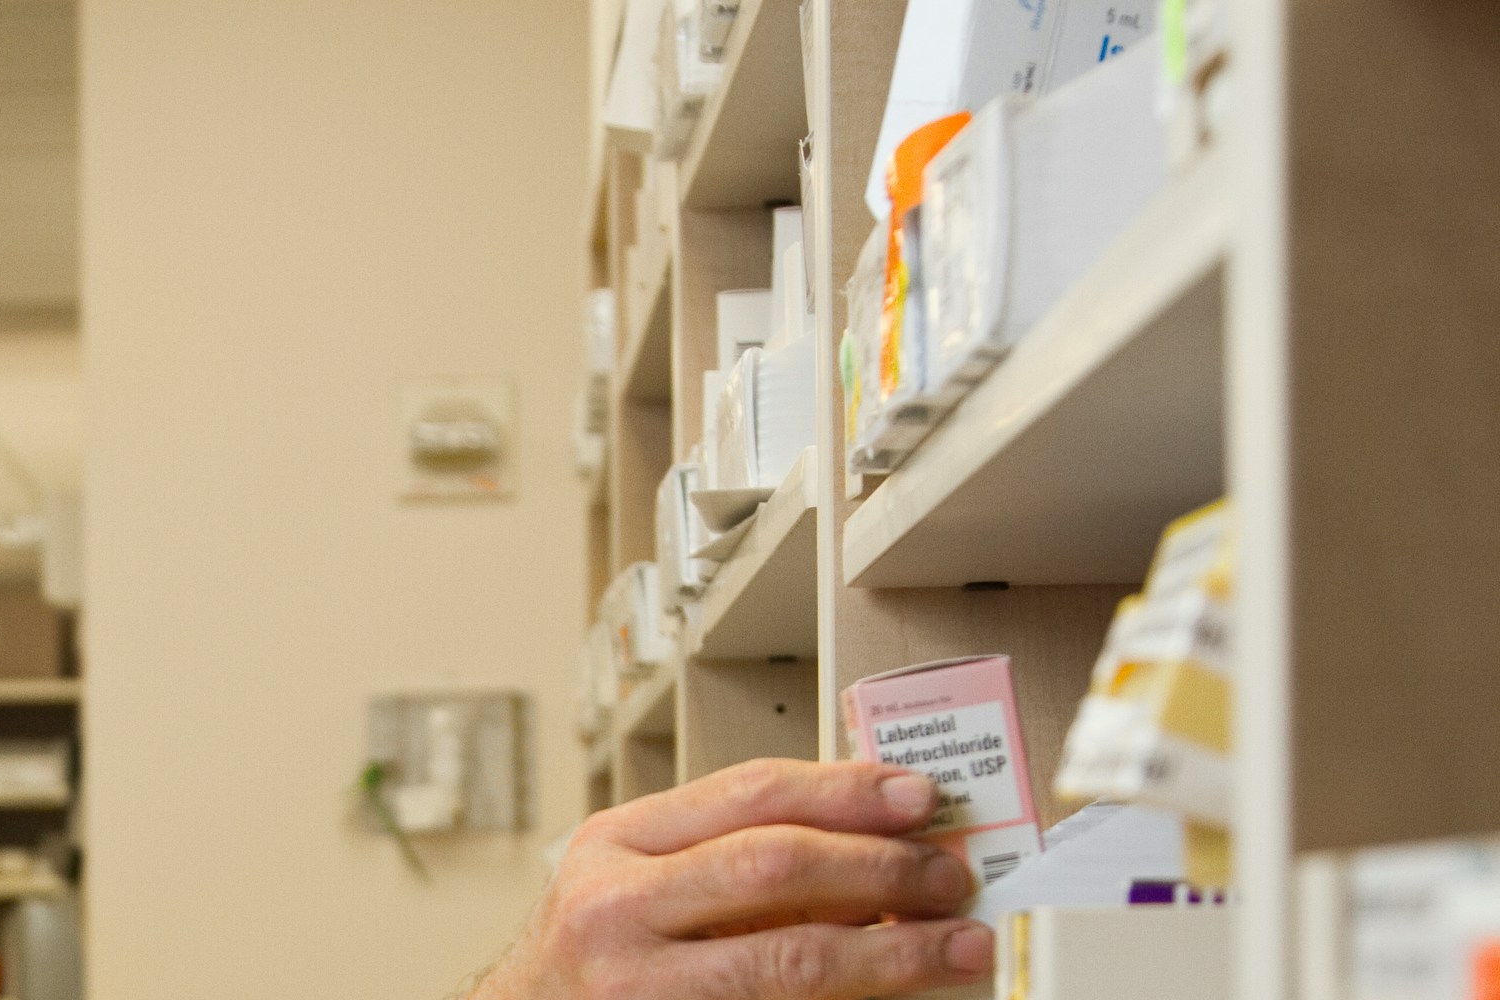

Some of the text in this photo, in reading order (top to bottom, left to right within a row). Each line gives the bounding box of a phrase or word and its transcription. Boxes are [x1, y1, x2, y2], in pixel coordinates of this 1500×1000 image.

[876, 713, 957, 745] Labetalol
[881, 732, 1003, 766] Hydrochloride
[969, 754, 1008, 778] USP
